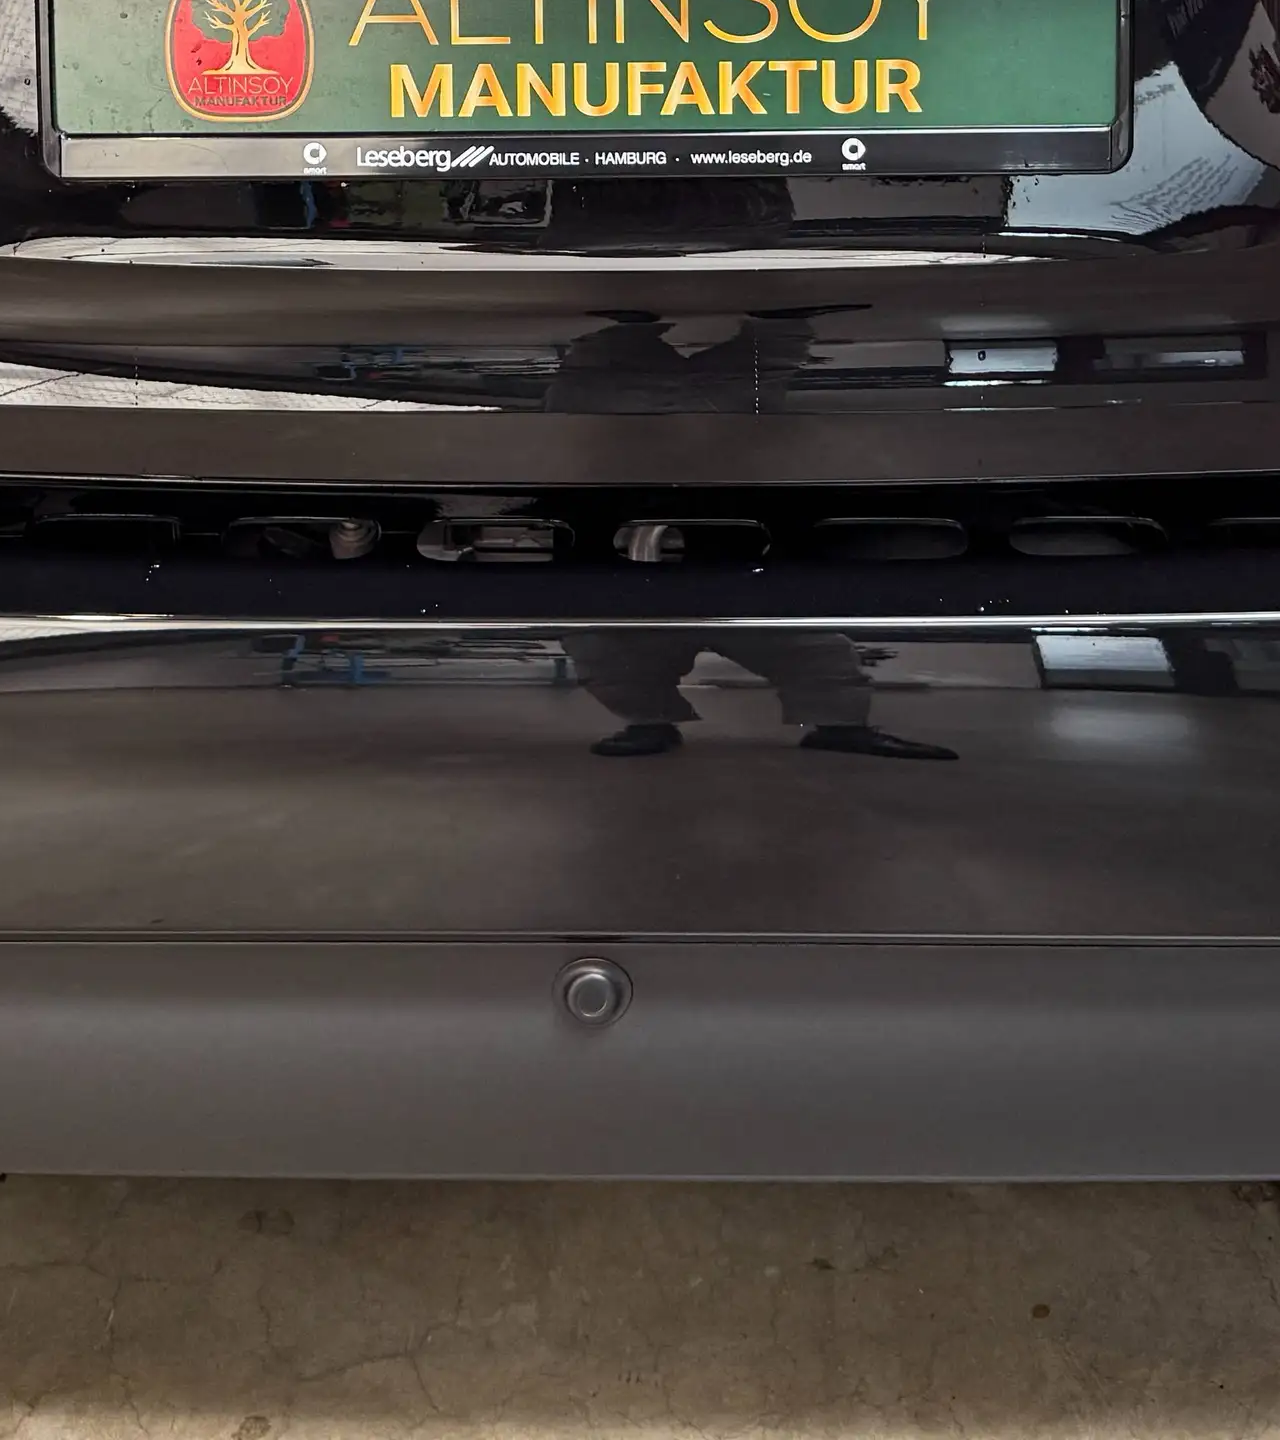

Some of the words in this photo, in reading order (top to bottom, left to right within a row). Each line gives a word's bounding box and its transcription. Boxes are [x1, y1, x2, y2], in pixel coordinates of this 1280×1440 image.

[188, 76, 294, 96] ALTINSOY
[390, 59, 924, 118] MANUFAKTUR
[194, 95, 287, 108] MANUFAKTUR
[356, 145, 451, 172] Leseberg
[488, 152, 580, 166] AUTOMOBILE
[595, 152, 667, 166] HAMBURG
[691, 149, 813, 166] www.leseberg.de
